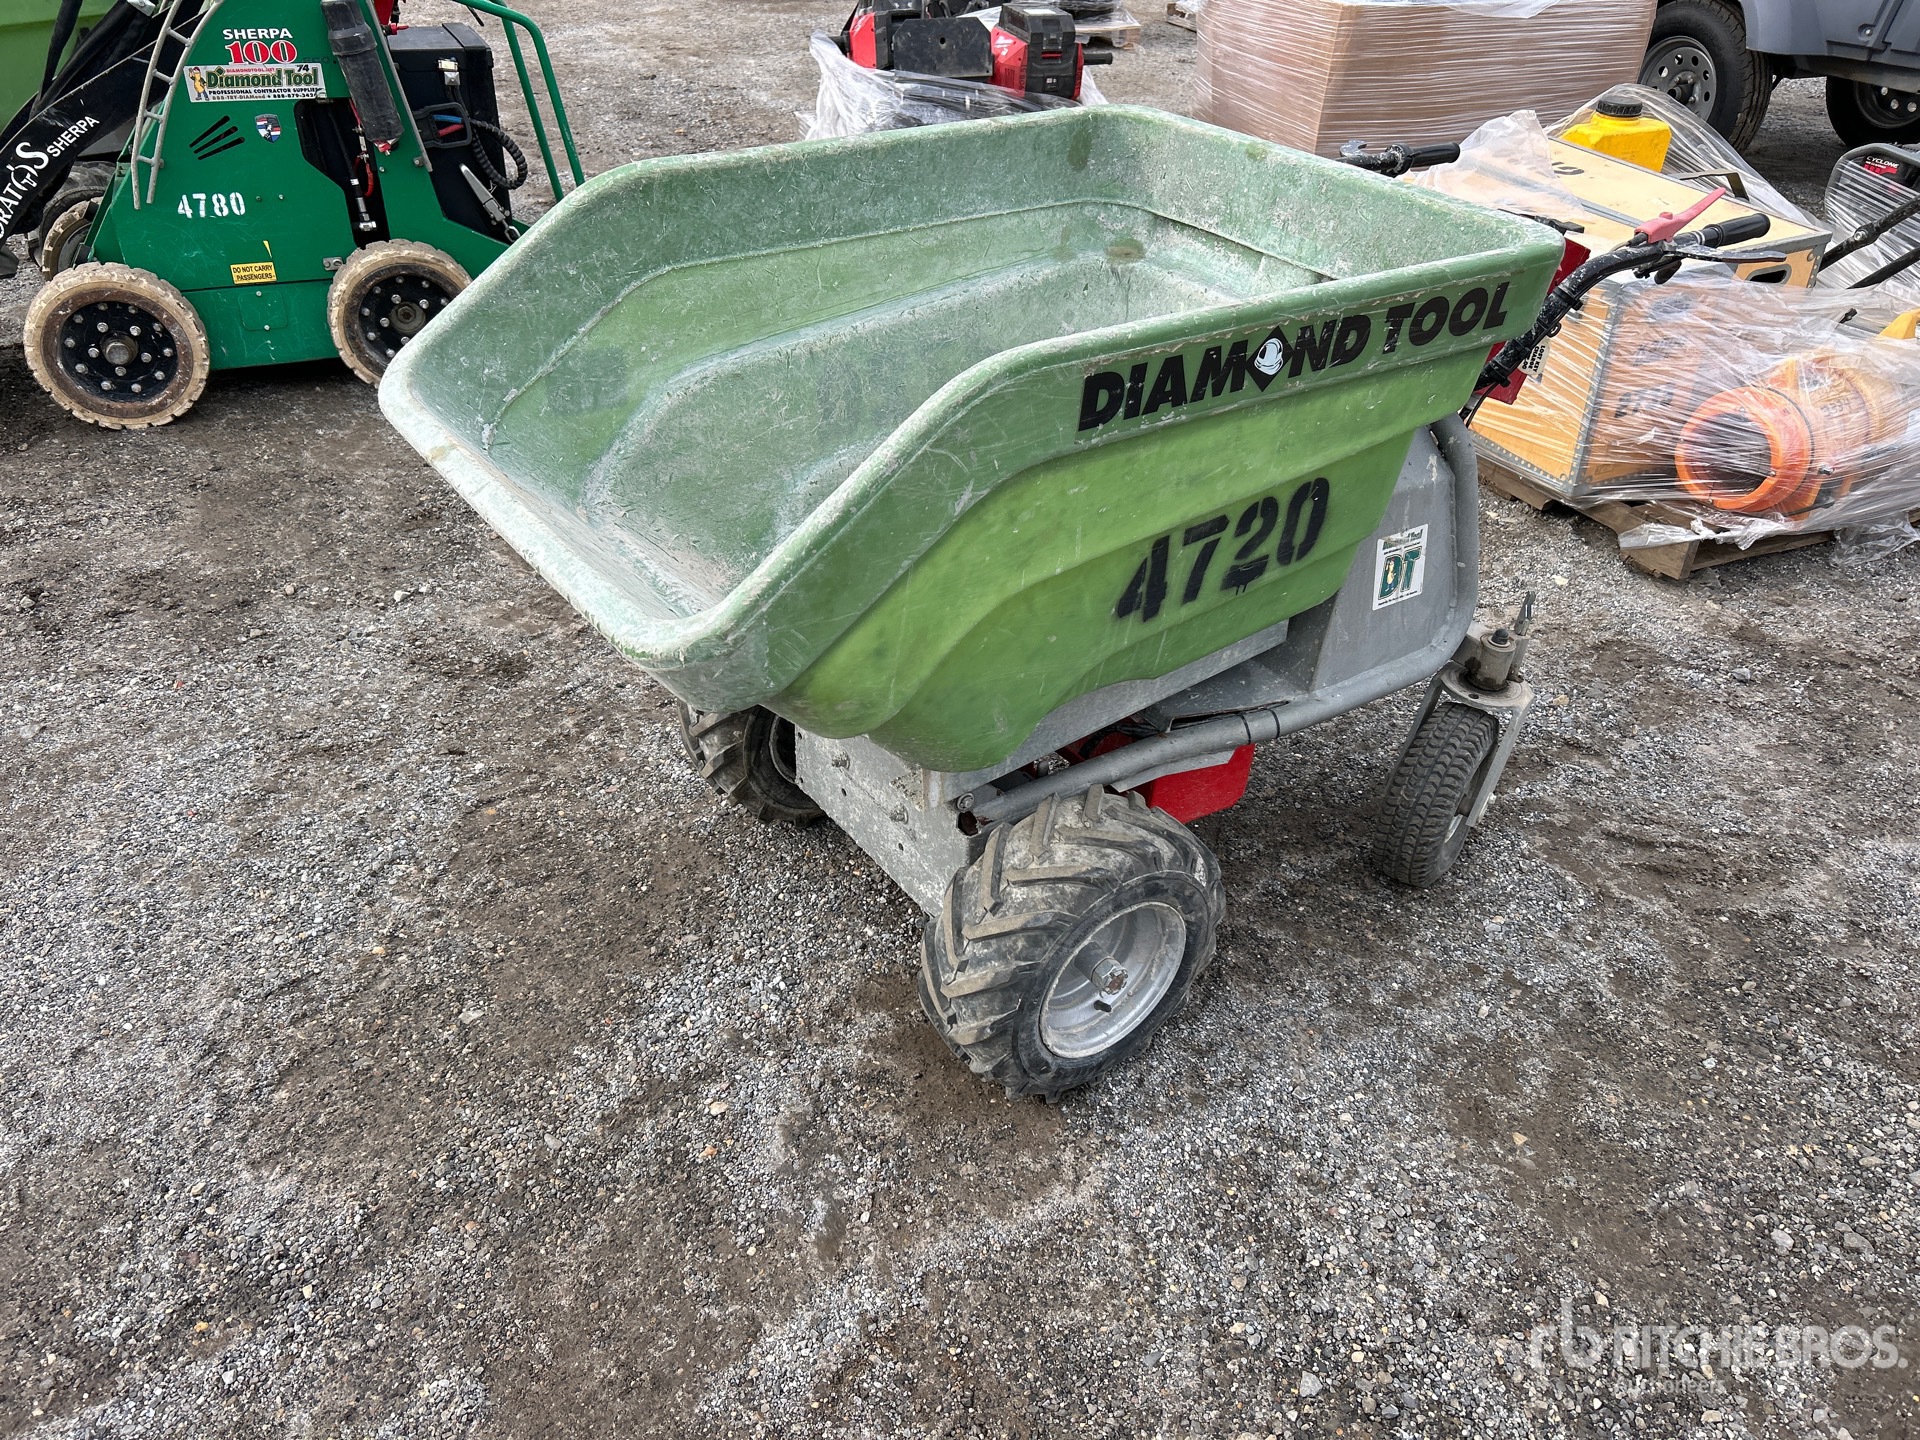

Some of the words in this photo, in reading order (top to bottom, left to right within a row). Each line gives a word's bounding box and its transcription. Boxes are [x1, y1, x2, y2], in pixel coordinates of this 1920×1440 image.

[222, 28, 293, 40] SHERPA
[225, 40, 298, 65] 100
[206, 65, 283, 89] Diamond
[283, 66, 320, 87] Tool
[46, 115, 100, 157] SHERPA
[1866, 155, 1900, 169] CYCLONE
[177, 192, 246, 219] 4780
[236, 272, 273, 281] PASSENGERS
[242, 265, 254, 273] NOT
[254, 264, 273, 272] CARRY
[1382, 281, 1511, 355] TOOL
[1537, 345, 1546, 360] LOST
[1533, 361, 1541, 372] KEY
[1114, 477, 1331, 623] 4720
[1378, 545, 1423, 601] DT
